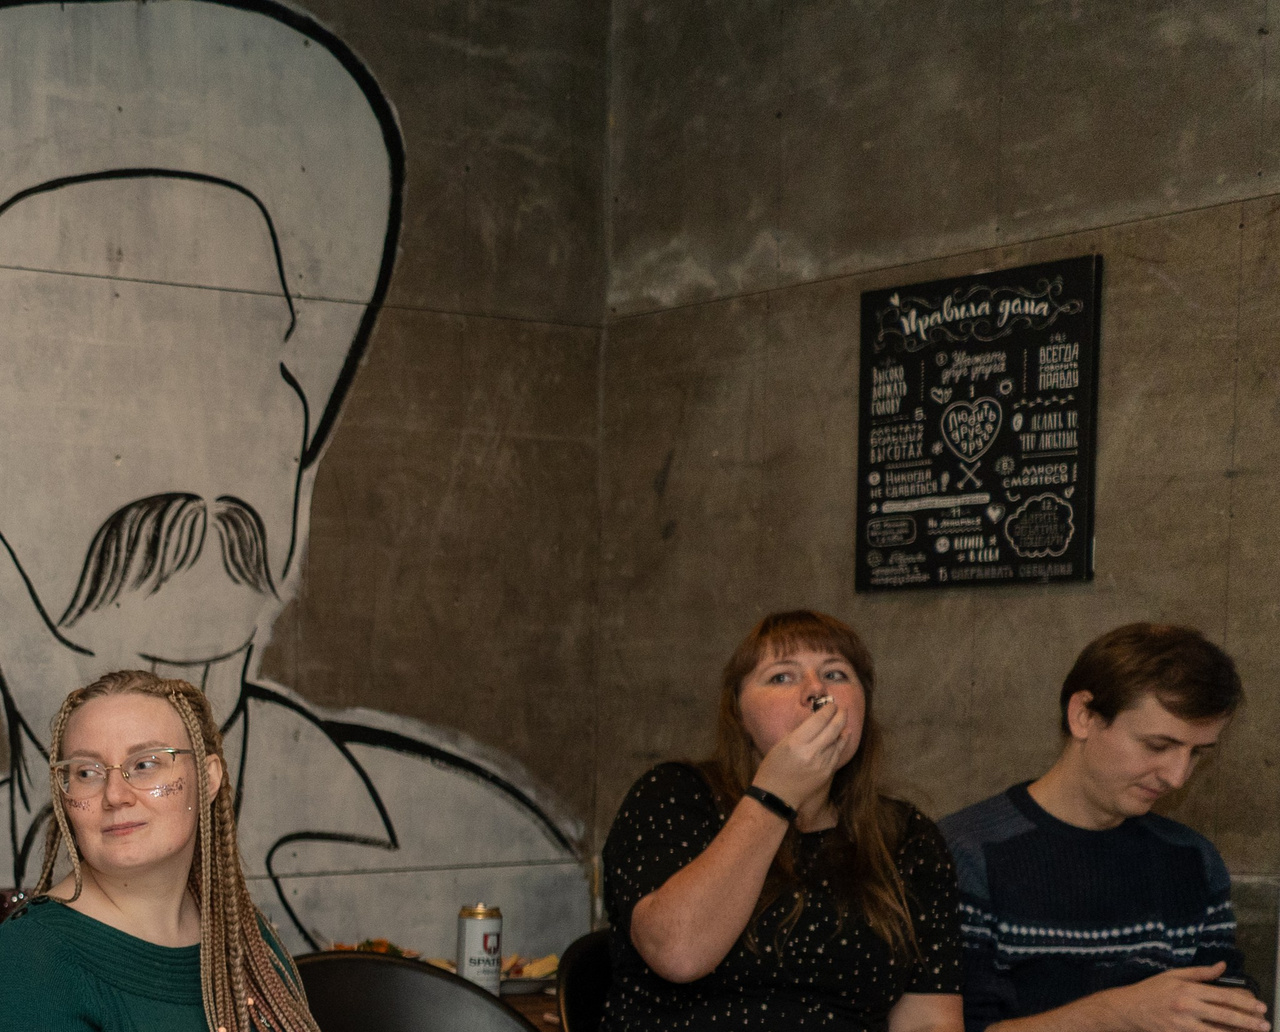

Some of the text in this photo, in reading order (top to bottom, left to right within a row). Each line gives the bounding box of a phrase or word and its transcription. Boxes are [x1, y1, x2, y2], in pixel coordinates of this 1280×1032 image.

[900, 295, 990, 341] Правила
[1039, 342, 1079, 364] ВСЕГДА
[1039, 369, 1079, 391] ПРАВДУ
